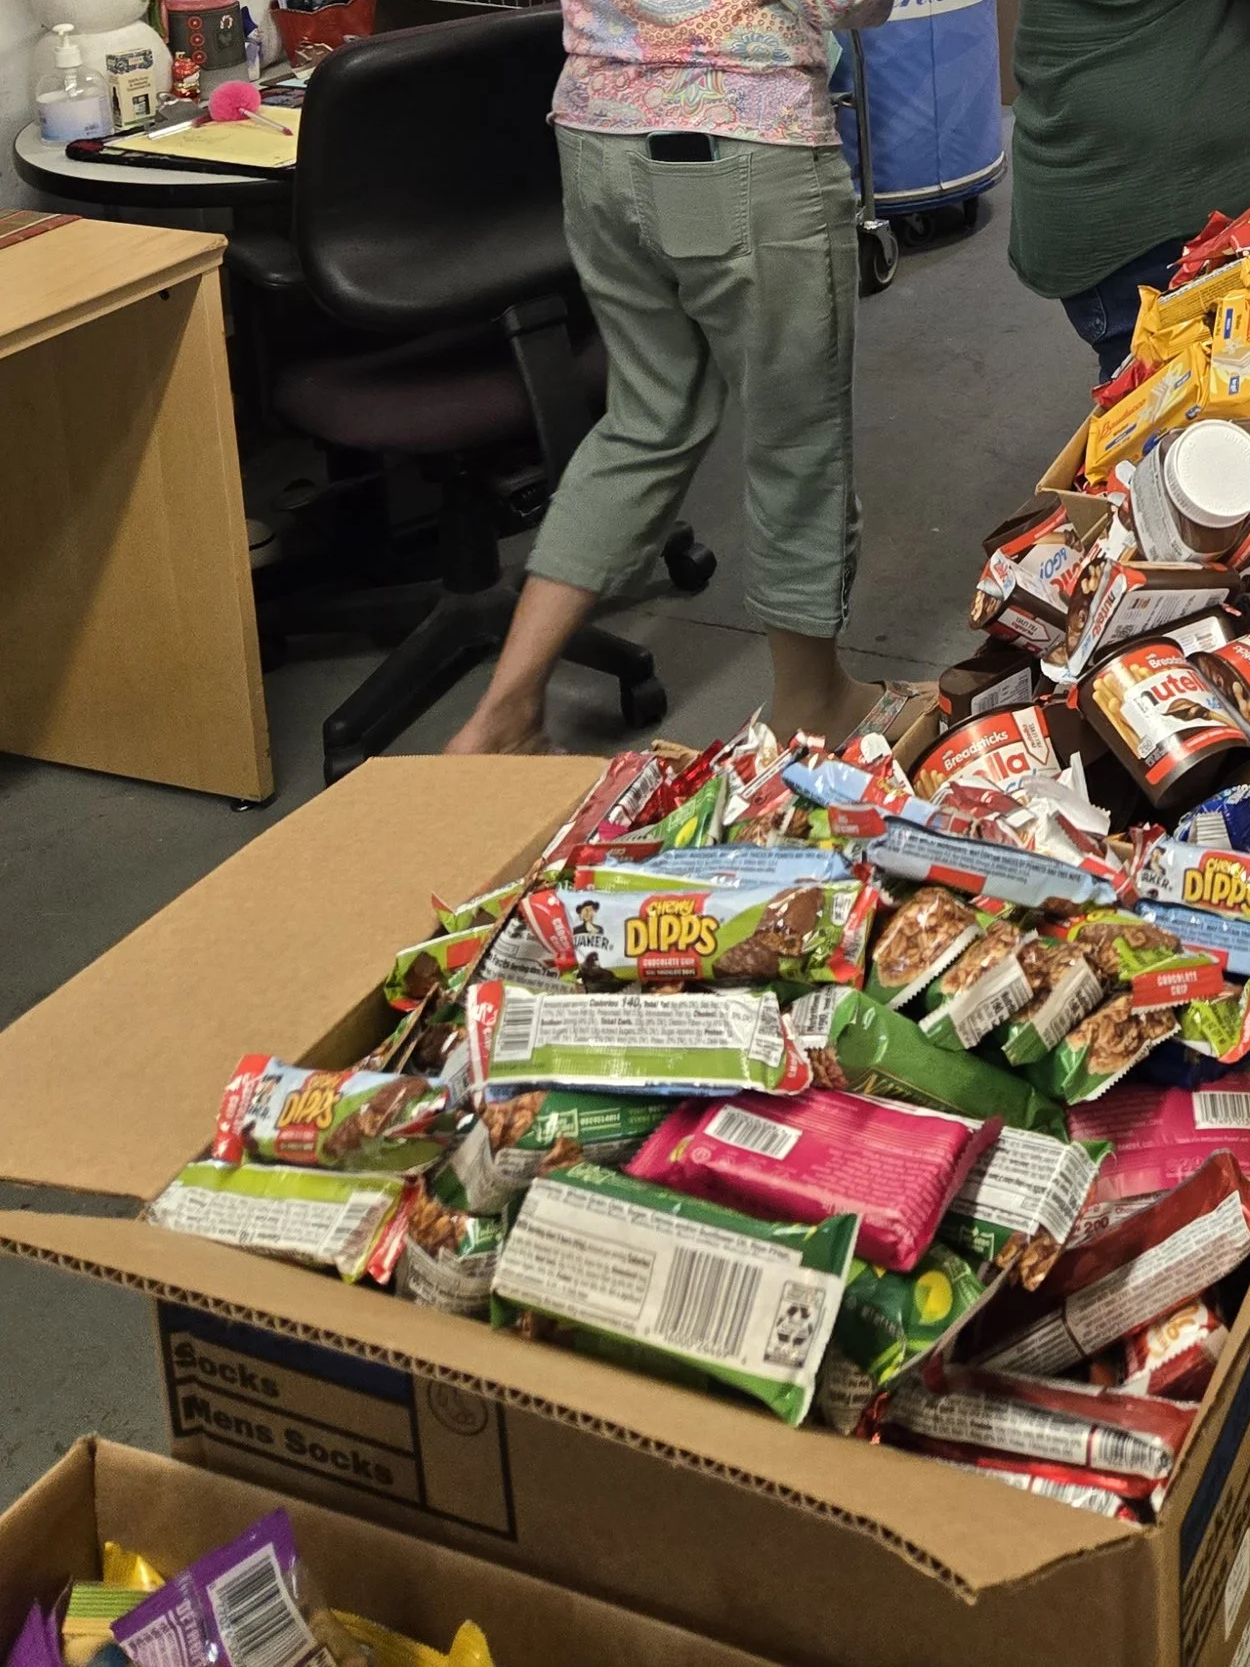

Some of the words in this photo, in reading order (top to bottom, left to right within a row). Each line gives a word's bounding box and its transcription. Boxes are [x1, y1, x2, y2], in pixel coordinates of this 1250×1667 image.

[1101, 398, 1147, 438] Bauducco
[944, 730, 1009, 771] Breadsticks
[648, 899, 695, 917] CHEWY
[574, 934, 610, 951] UAKER
[624, 914, 719, 958] DIPPS
[643, 958, 678, 968] CHOCOLATE
[1157, 971, 1197, 987] CHOCOLATE
[173, 1340, 281, 1399] Socks
[182, 1391, 273, 1443] Mens
[285, 1427, 394, 1486] Socks
